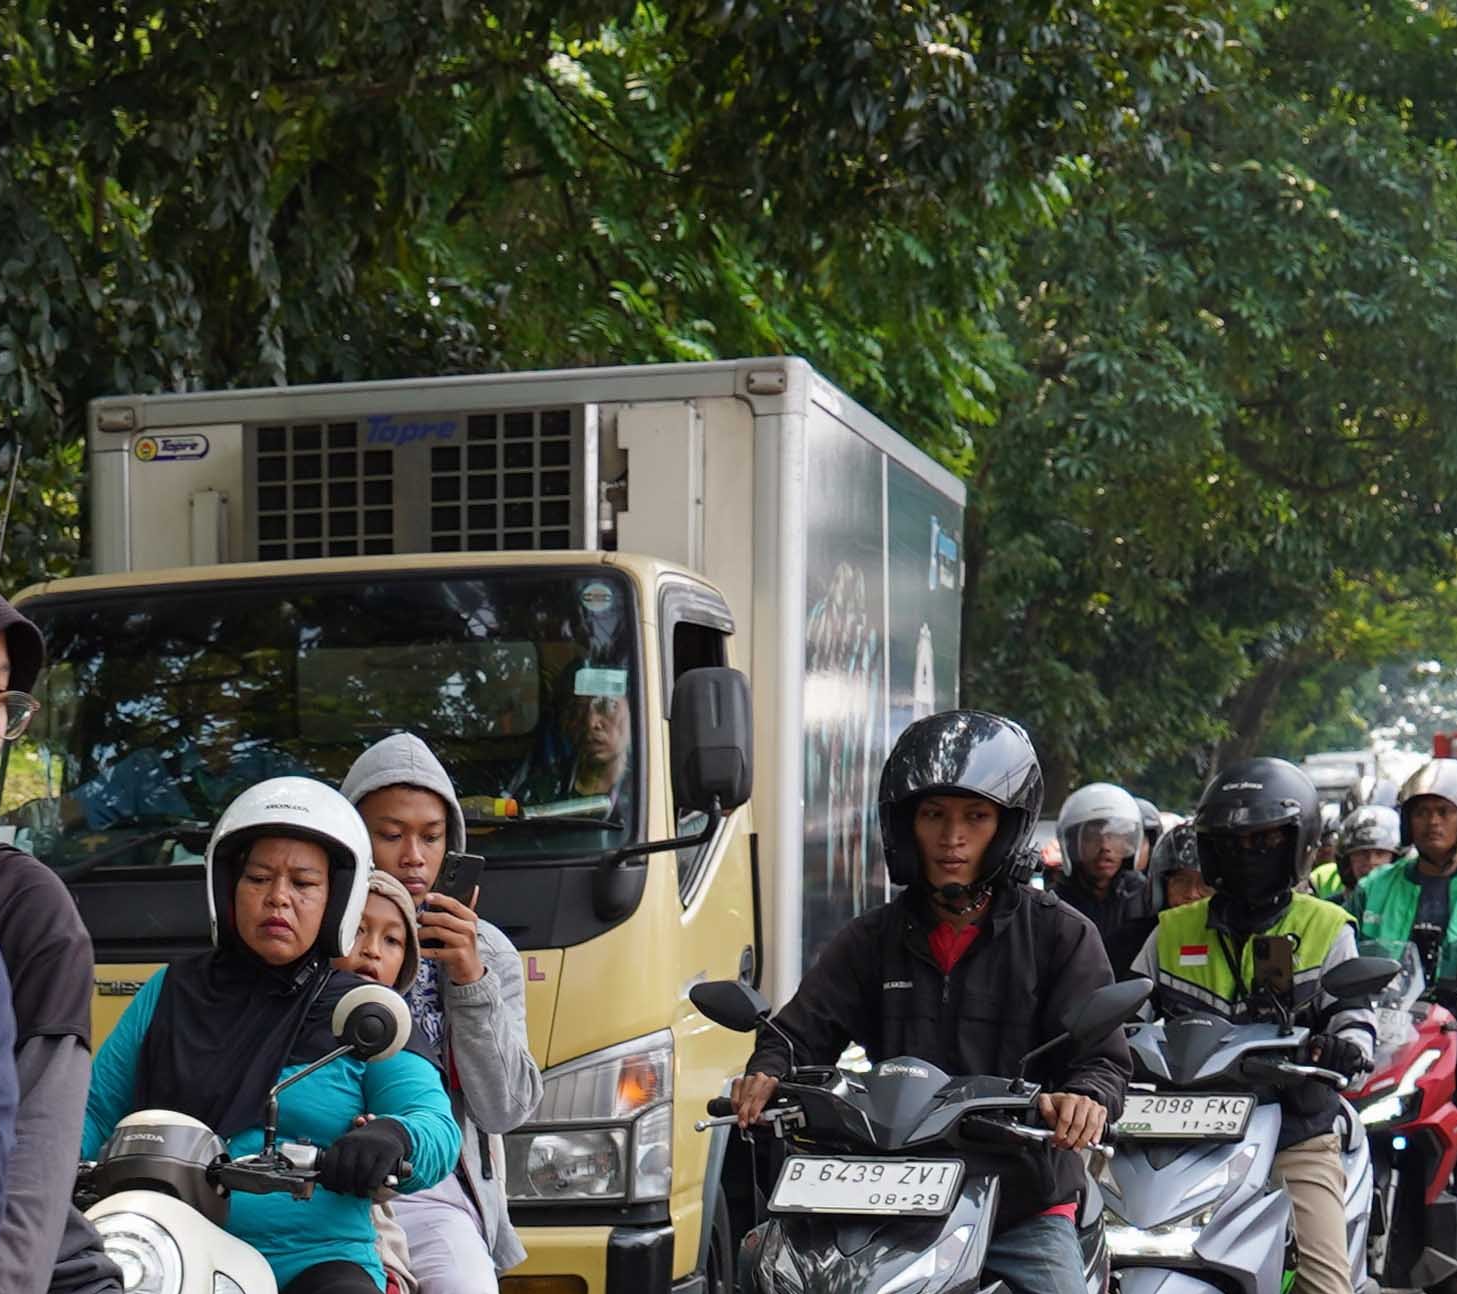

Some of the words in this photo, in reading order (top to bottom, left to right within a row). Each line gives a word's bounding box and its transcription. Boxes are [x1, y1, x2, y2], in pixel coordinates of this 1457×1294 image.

[366, 415, 457, 446] Topre
[527, 955, 546, 982] L
[1141, 1099, 1194, 1115] 2098
[1204, 1099, 1245, 1116] FKC
[789, 1162, 806, 1182] B
[818, 1163, 886, 1184] 6439
